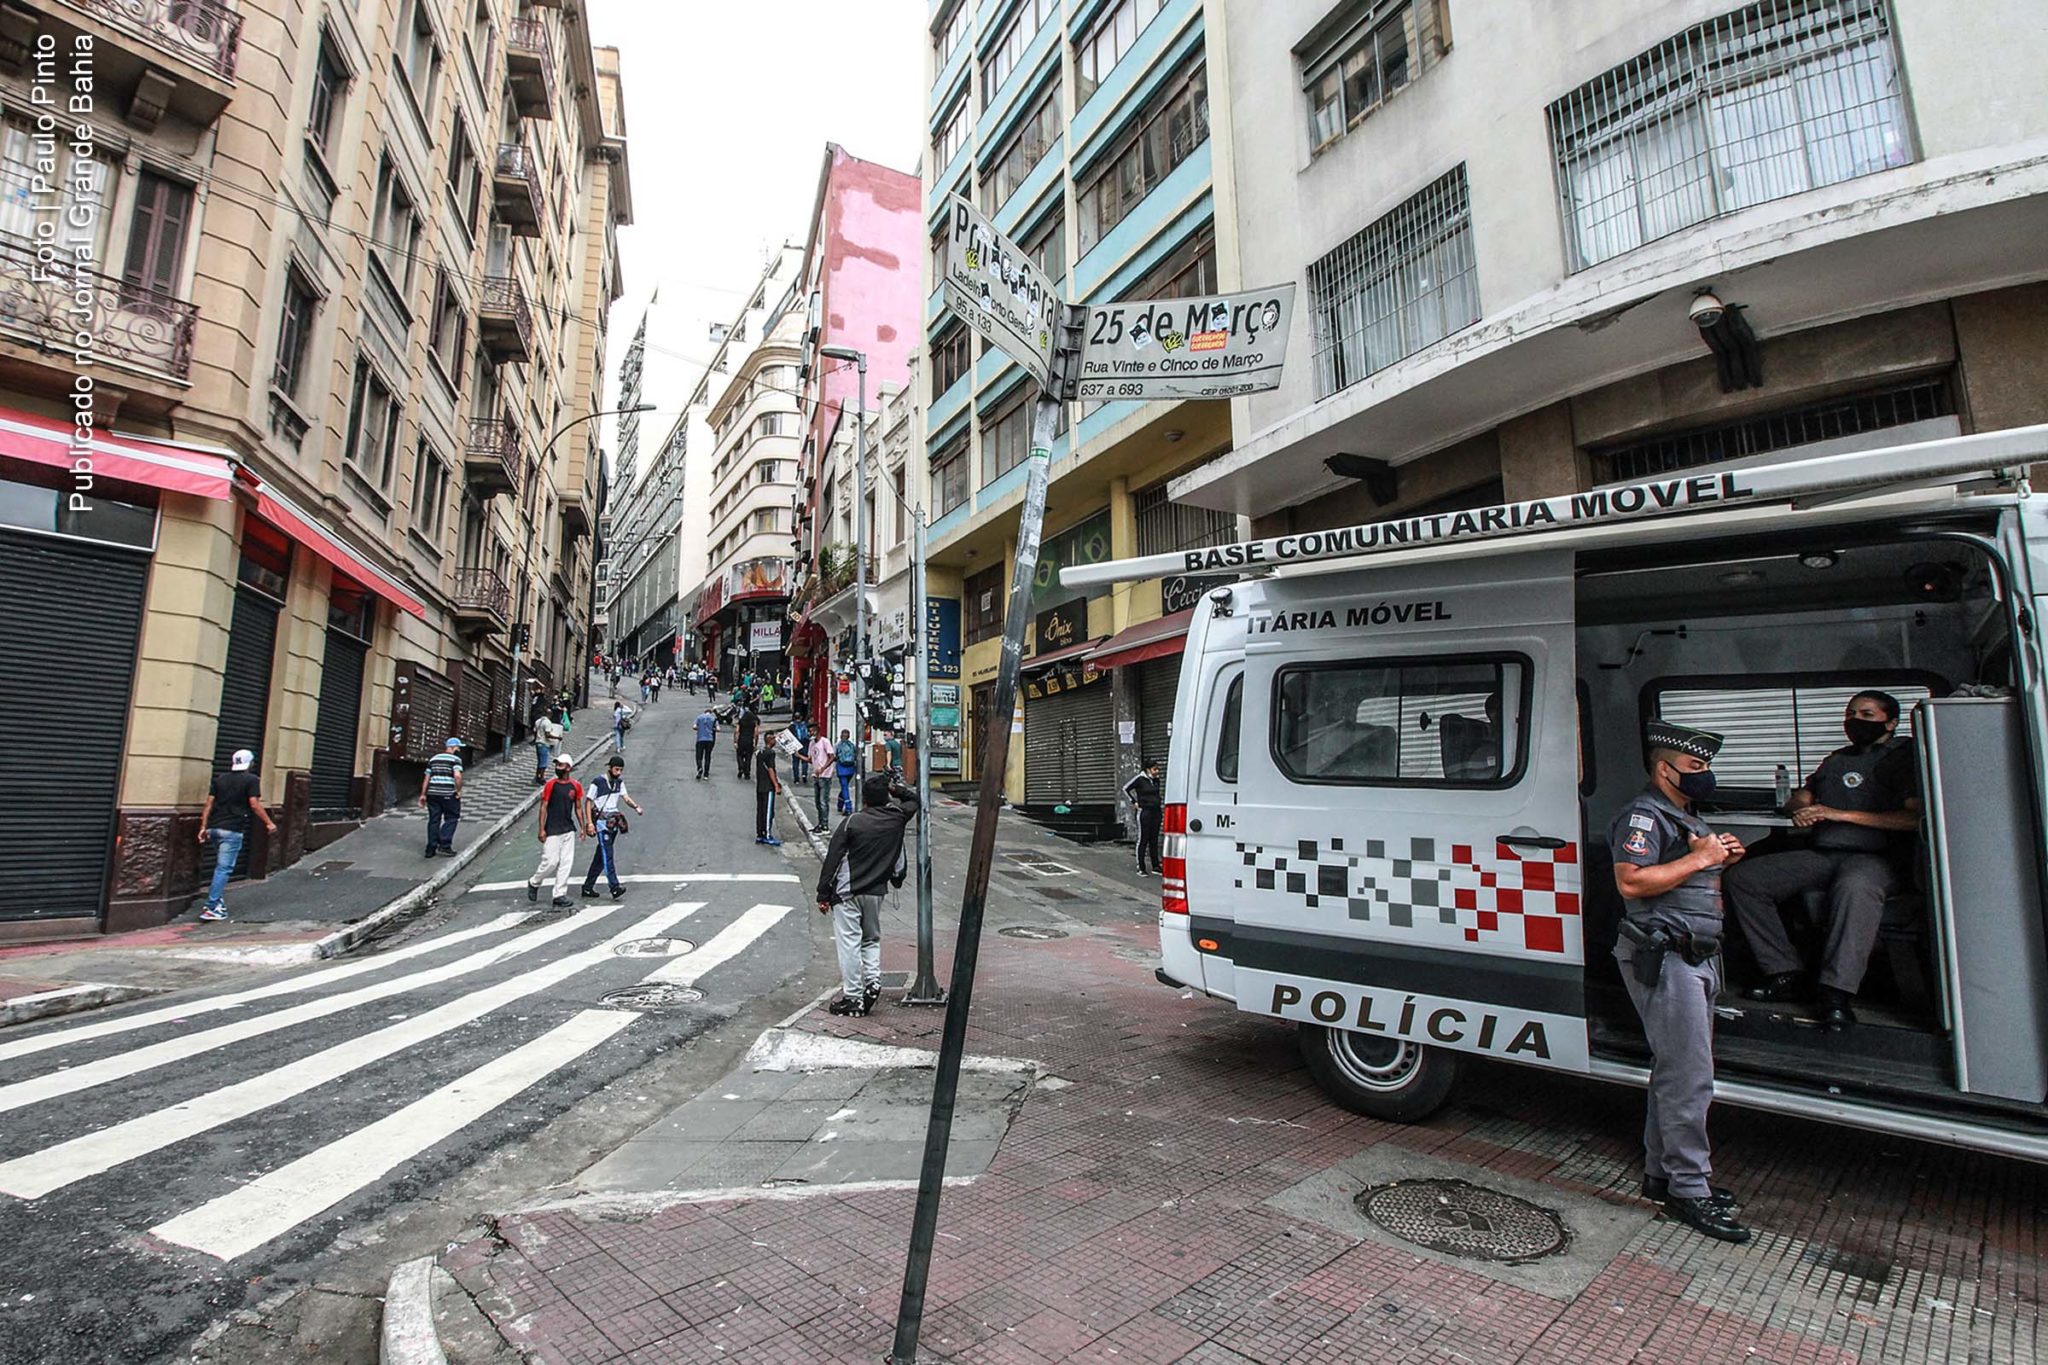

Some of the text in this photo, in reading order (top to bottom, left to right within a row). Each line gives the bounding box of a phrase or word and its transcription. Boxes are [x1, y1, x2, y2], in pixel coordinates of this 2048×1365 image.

[956, 296, 992, 333] 95 a 133
[991, 298, 1007, 318] orto
[1090, 309, 1125, 346] 25
[1137, 304, 1173, 341] de
[1184, 298, 1281, 345] Mrço
[1084, 352, 1263, 374] Rua Vinte e Cinco de Março
[1080, 383, 1143, 396] 637 a 693
[1184, 472, 1753, 573] BASE COMUNITARIA MOVEL
[1044, 612, 1073, 641] Ônix
[1346, 600, 1452, 627] MÓVEL
[753, 627, 781, 638] MILLA
[928, 601, 941, 672] BIJUTERIAS
[942, 665, 959, 674] 123
[1270, 983, 1552, 1060] POLÍCIA
